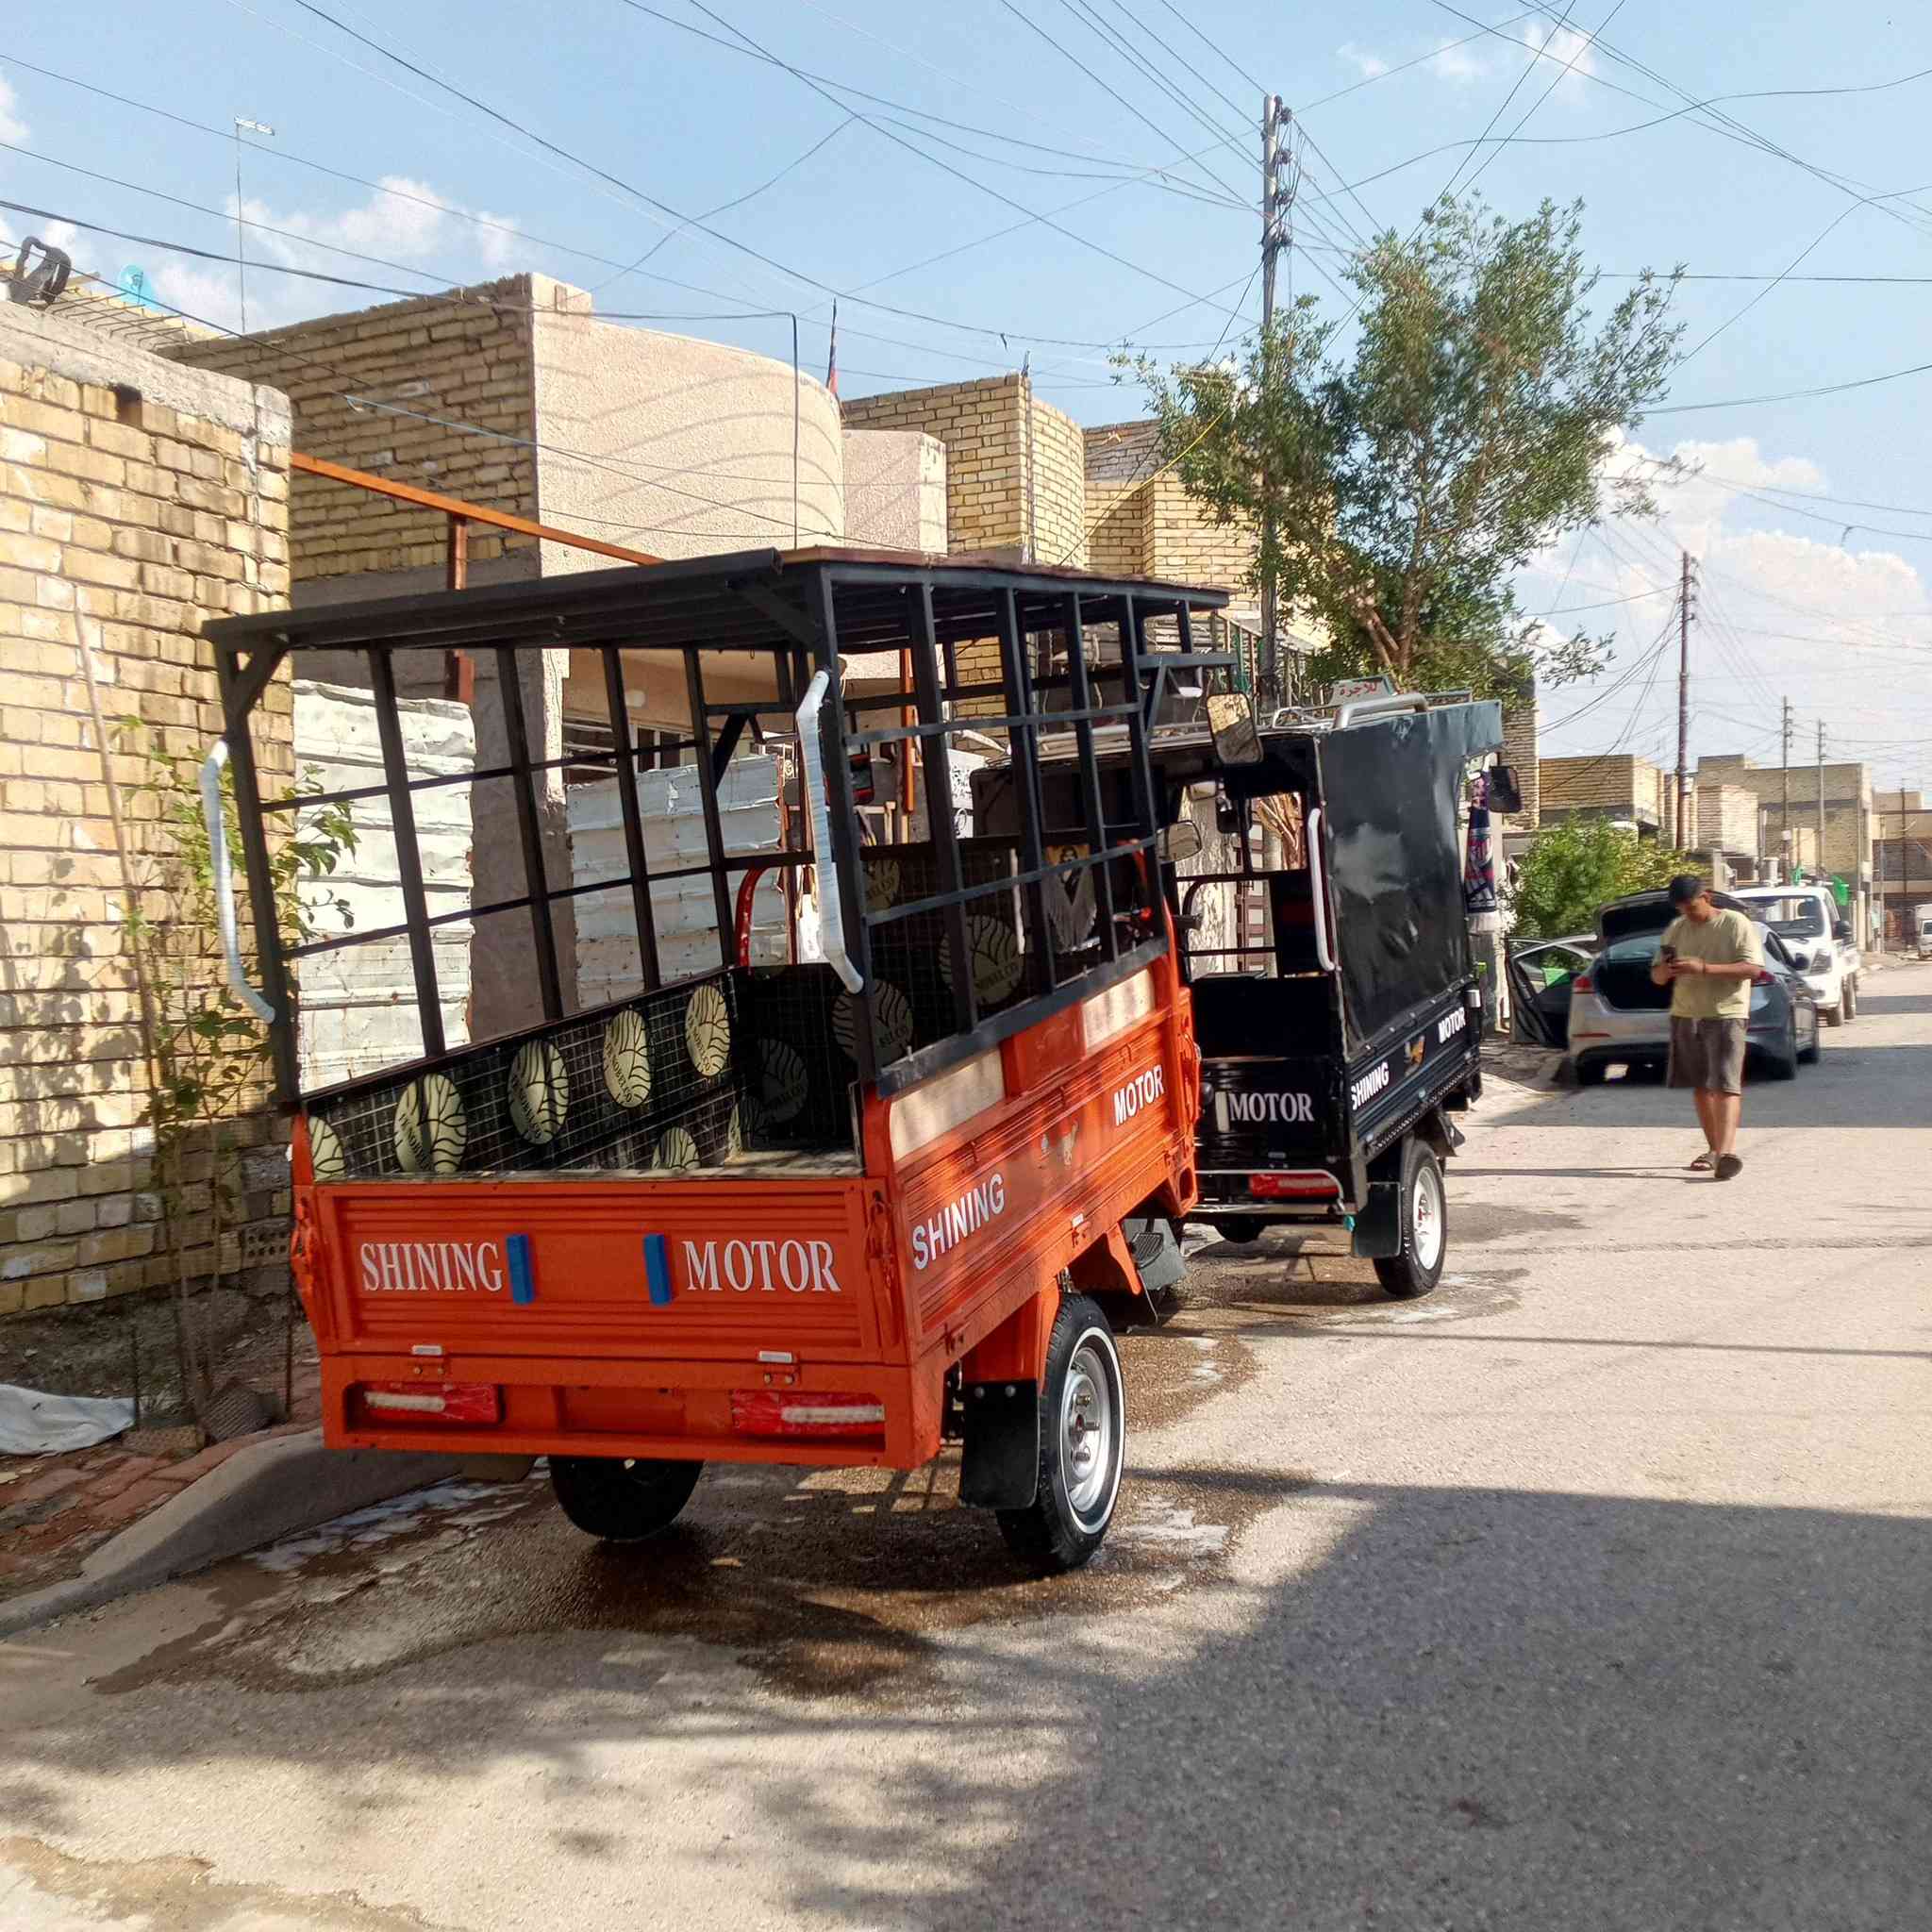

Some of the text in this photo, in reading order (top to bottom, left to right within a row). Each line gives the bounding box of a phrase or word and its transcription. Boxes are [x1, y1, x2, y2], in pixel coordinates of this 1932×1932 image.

[1351, 1007, 1466, 1110] SHINING MOTOR
[1228, 1092, 1315, 1123] MOTOR
[912, 1064, 1165, 1270] SHINING MOTOR
[360, 1240, 841, 1292] SHINING MOTOR
